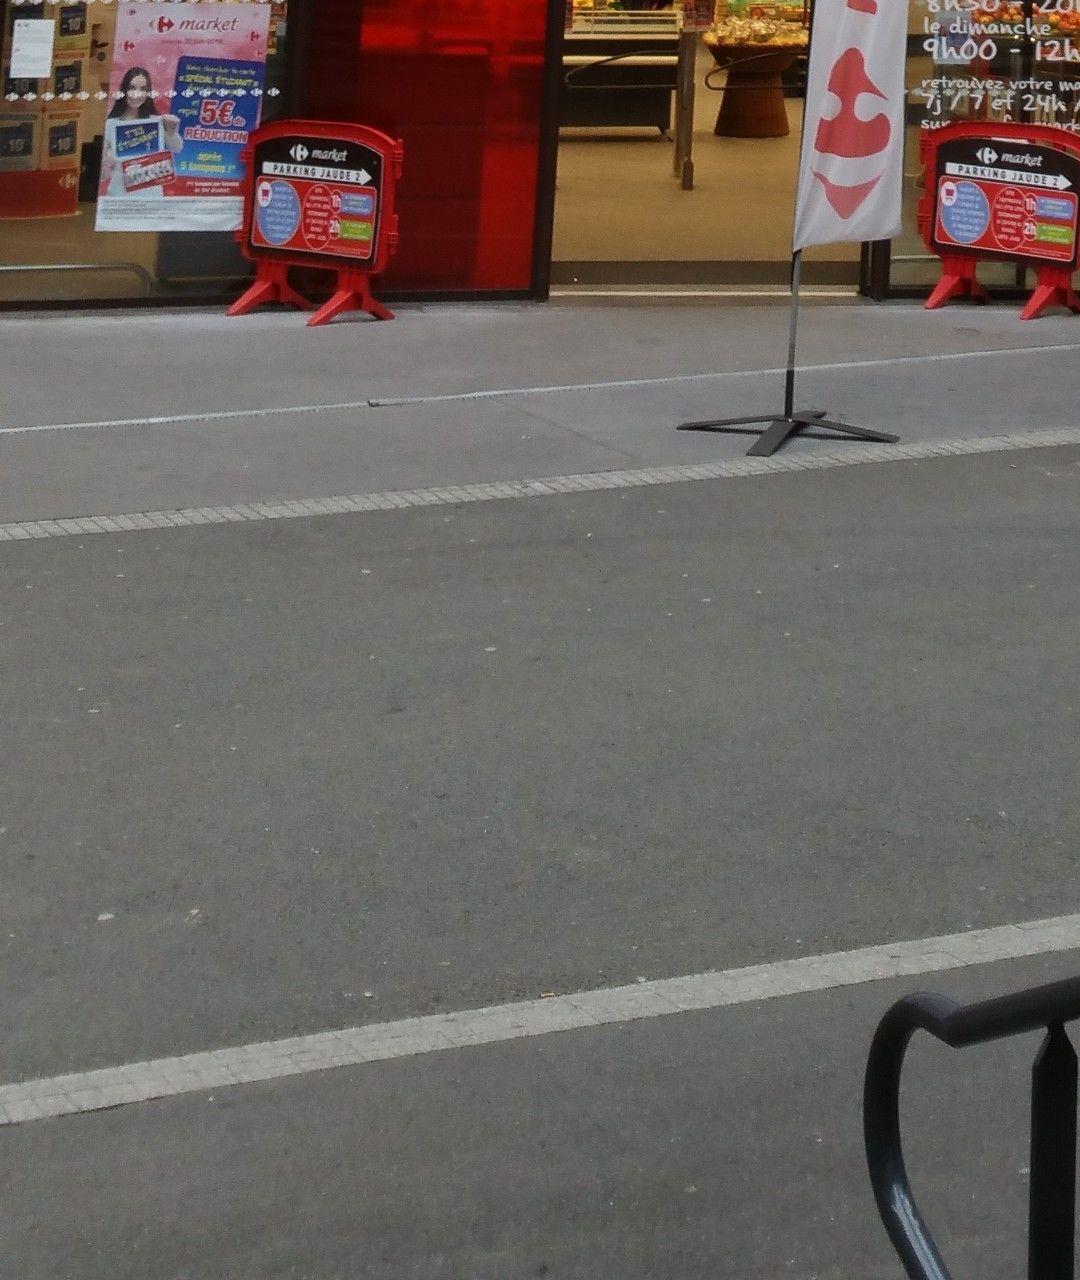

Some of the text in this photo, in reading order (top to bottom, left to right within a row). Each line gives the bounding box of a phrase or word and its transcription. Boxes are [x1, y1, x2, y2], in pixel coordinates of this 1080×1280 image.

[179, 16, 240, 33] market
[924, 16, 1051, 37] le dimanche
[923, 36, 998, 61] 9h00
[921, 75, 1004, 89] retrouvez
[1009, 76, 1054, 90] votre
[991, 94, 1014, 111] et
[1022, 95, 1068, 112] 24h
[311, 148, 348, 162] market
[1001, 152, 1044, 167] market
[272, 164, 316, 178] PARKING
[320, 169, 351, 181] JAUDE
[958, 165, 1006, 180] PARKING
[1011, 172, 1048, 185] JAUDE
